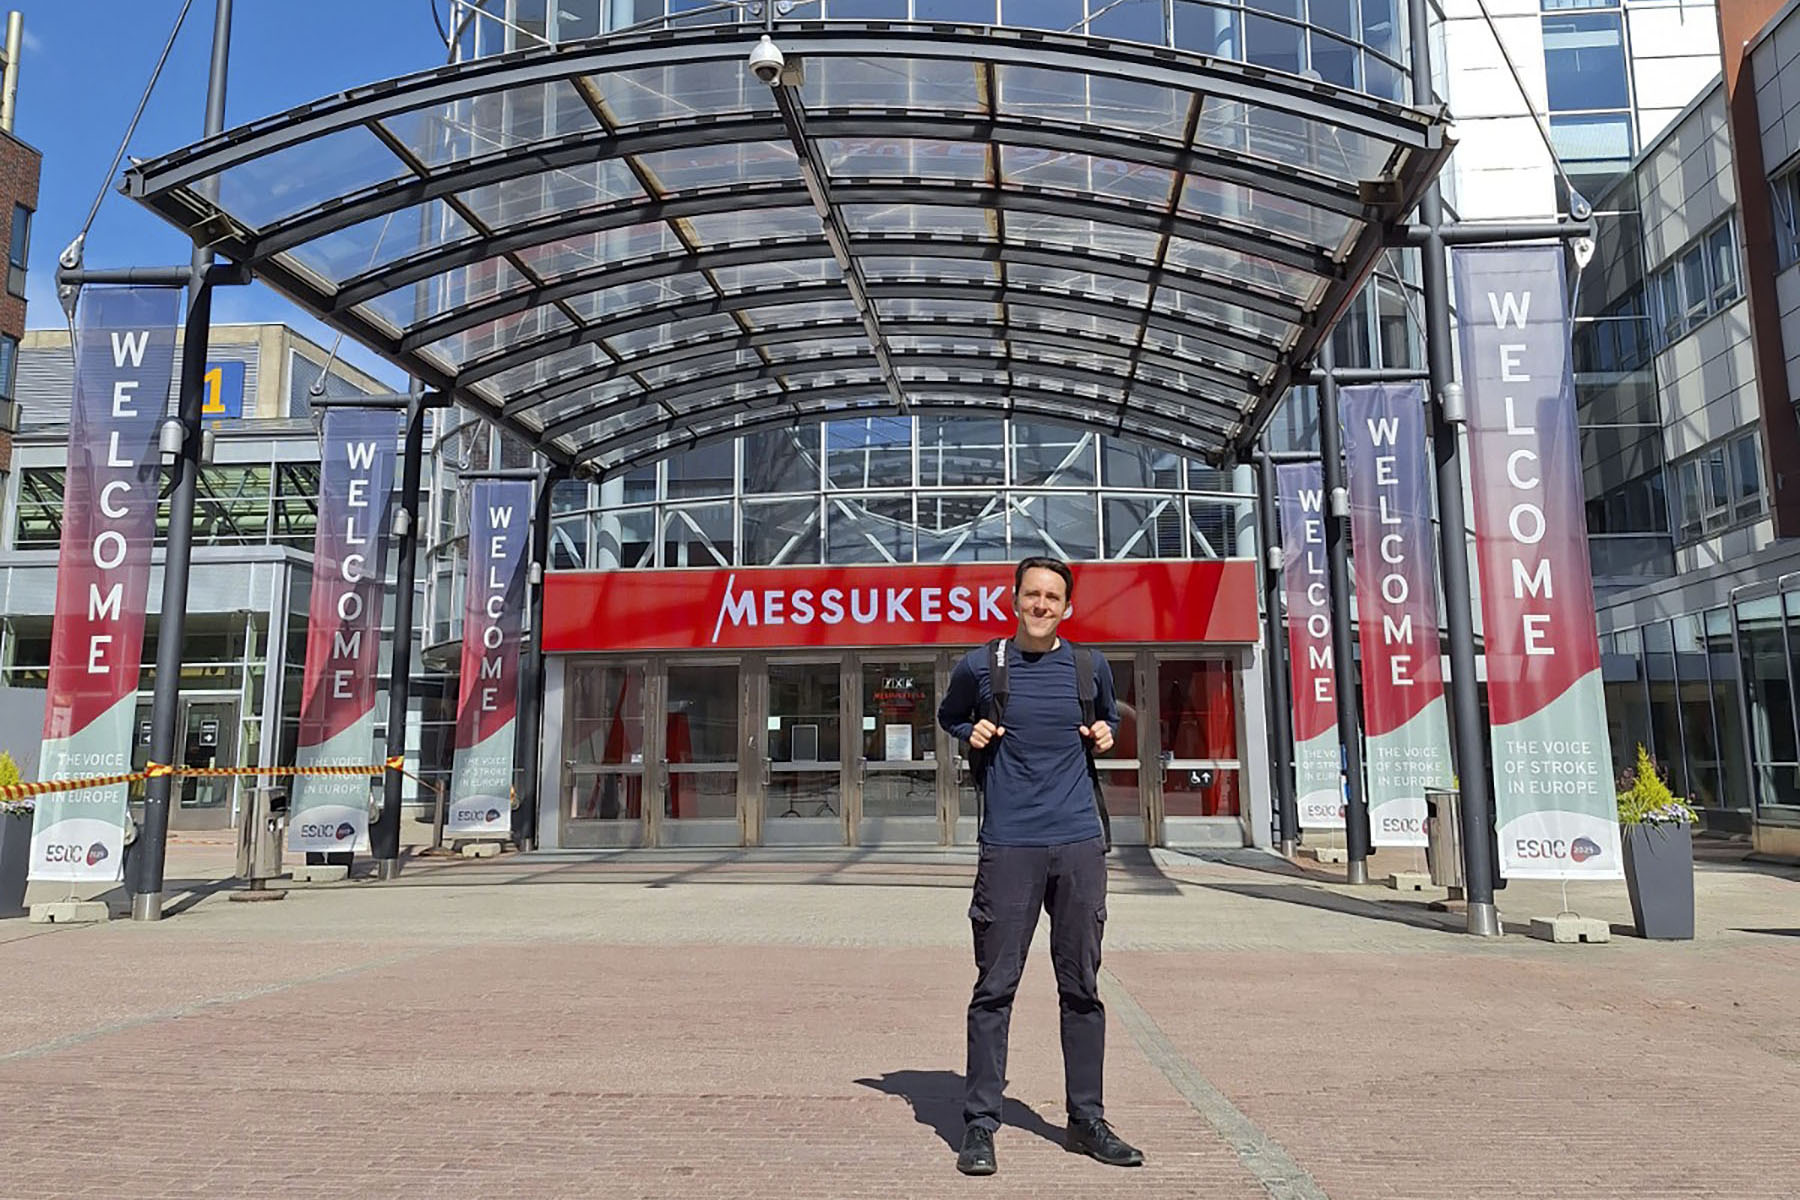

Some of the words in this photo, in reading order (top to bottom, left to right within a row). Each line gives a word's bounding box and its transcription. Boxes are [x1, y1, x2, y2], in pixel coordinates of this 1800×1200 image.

[1487, 291, 1555, 655] WELCOME
[87, 331, 149, 674] WELCOME
[1367, 417, 1415, 686] WELCOME
[333, 442, 377, 699] WELCOME
[1298, 489, 1333, 702] WELCOME
[480, 506, 513, 712] WELCOME
[712, 573, 1073, 643] MESSUKESK
[1377, 747, 1400, 757] THE
[1403, 747, 1439, 758] VOICE
[1506, 741, 1539, 754] THE
[1542, 741, 1592, 754] VOICE
[57, 753, 81, 766] THE
[82, 753, 124, 766] VOICE
[1376, 761, 1392, 772] OF
[1394, 761, 1441, 772] STROKE
[1504, 760, 1525, 774] OF
[1530, 760, 1598, 775] STROKE
[319, 783, 362, 794] EUROPE
[1377, 776, 1390, 786] IN
[1393, 776, 1442, 787] EUROPE
[1508, 780, 1525, 794] IN
[1530, 780, 1599, 794] EUROPE
[51, 791, 65, 803] IN
[69, 791, 120, 803] EUROPE
[1383, 818, 1419, 832] ESOC
[1516, 839, 1566, 859] ESOC
